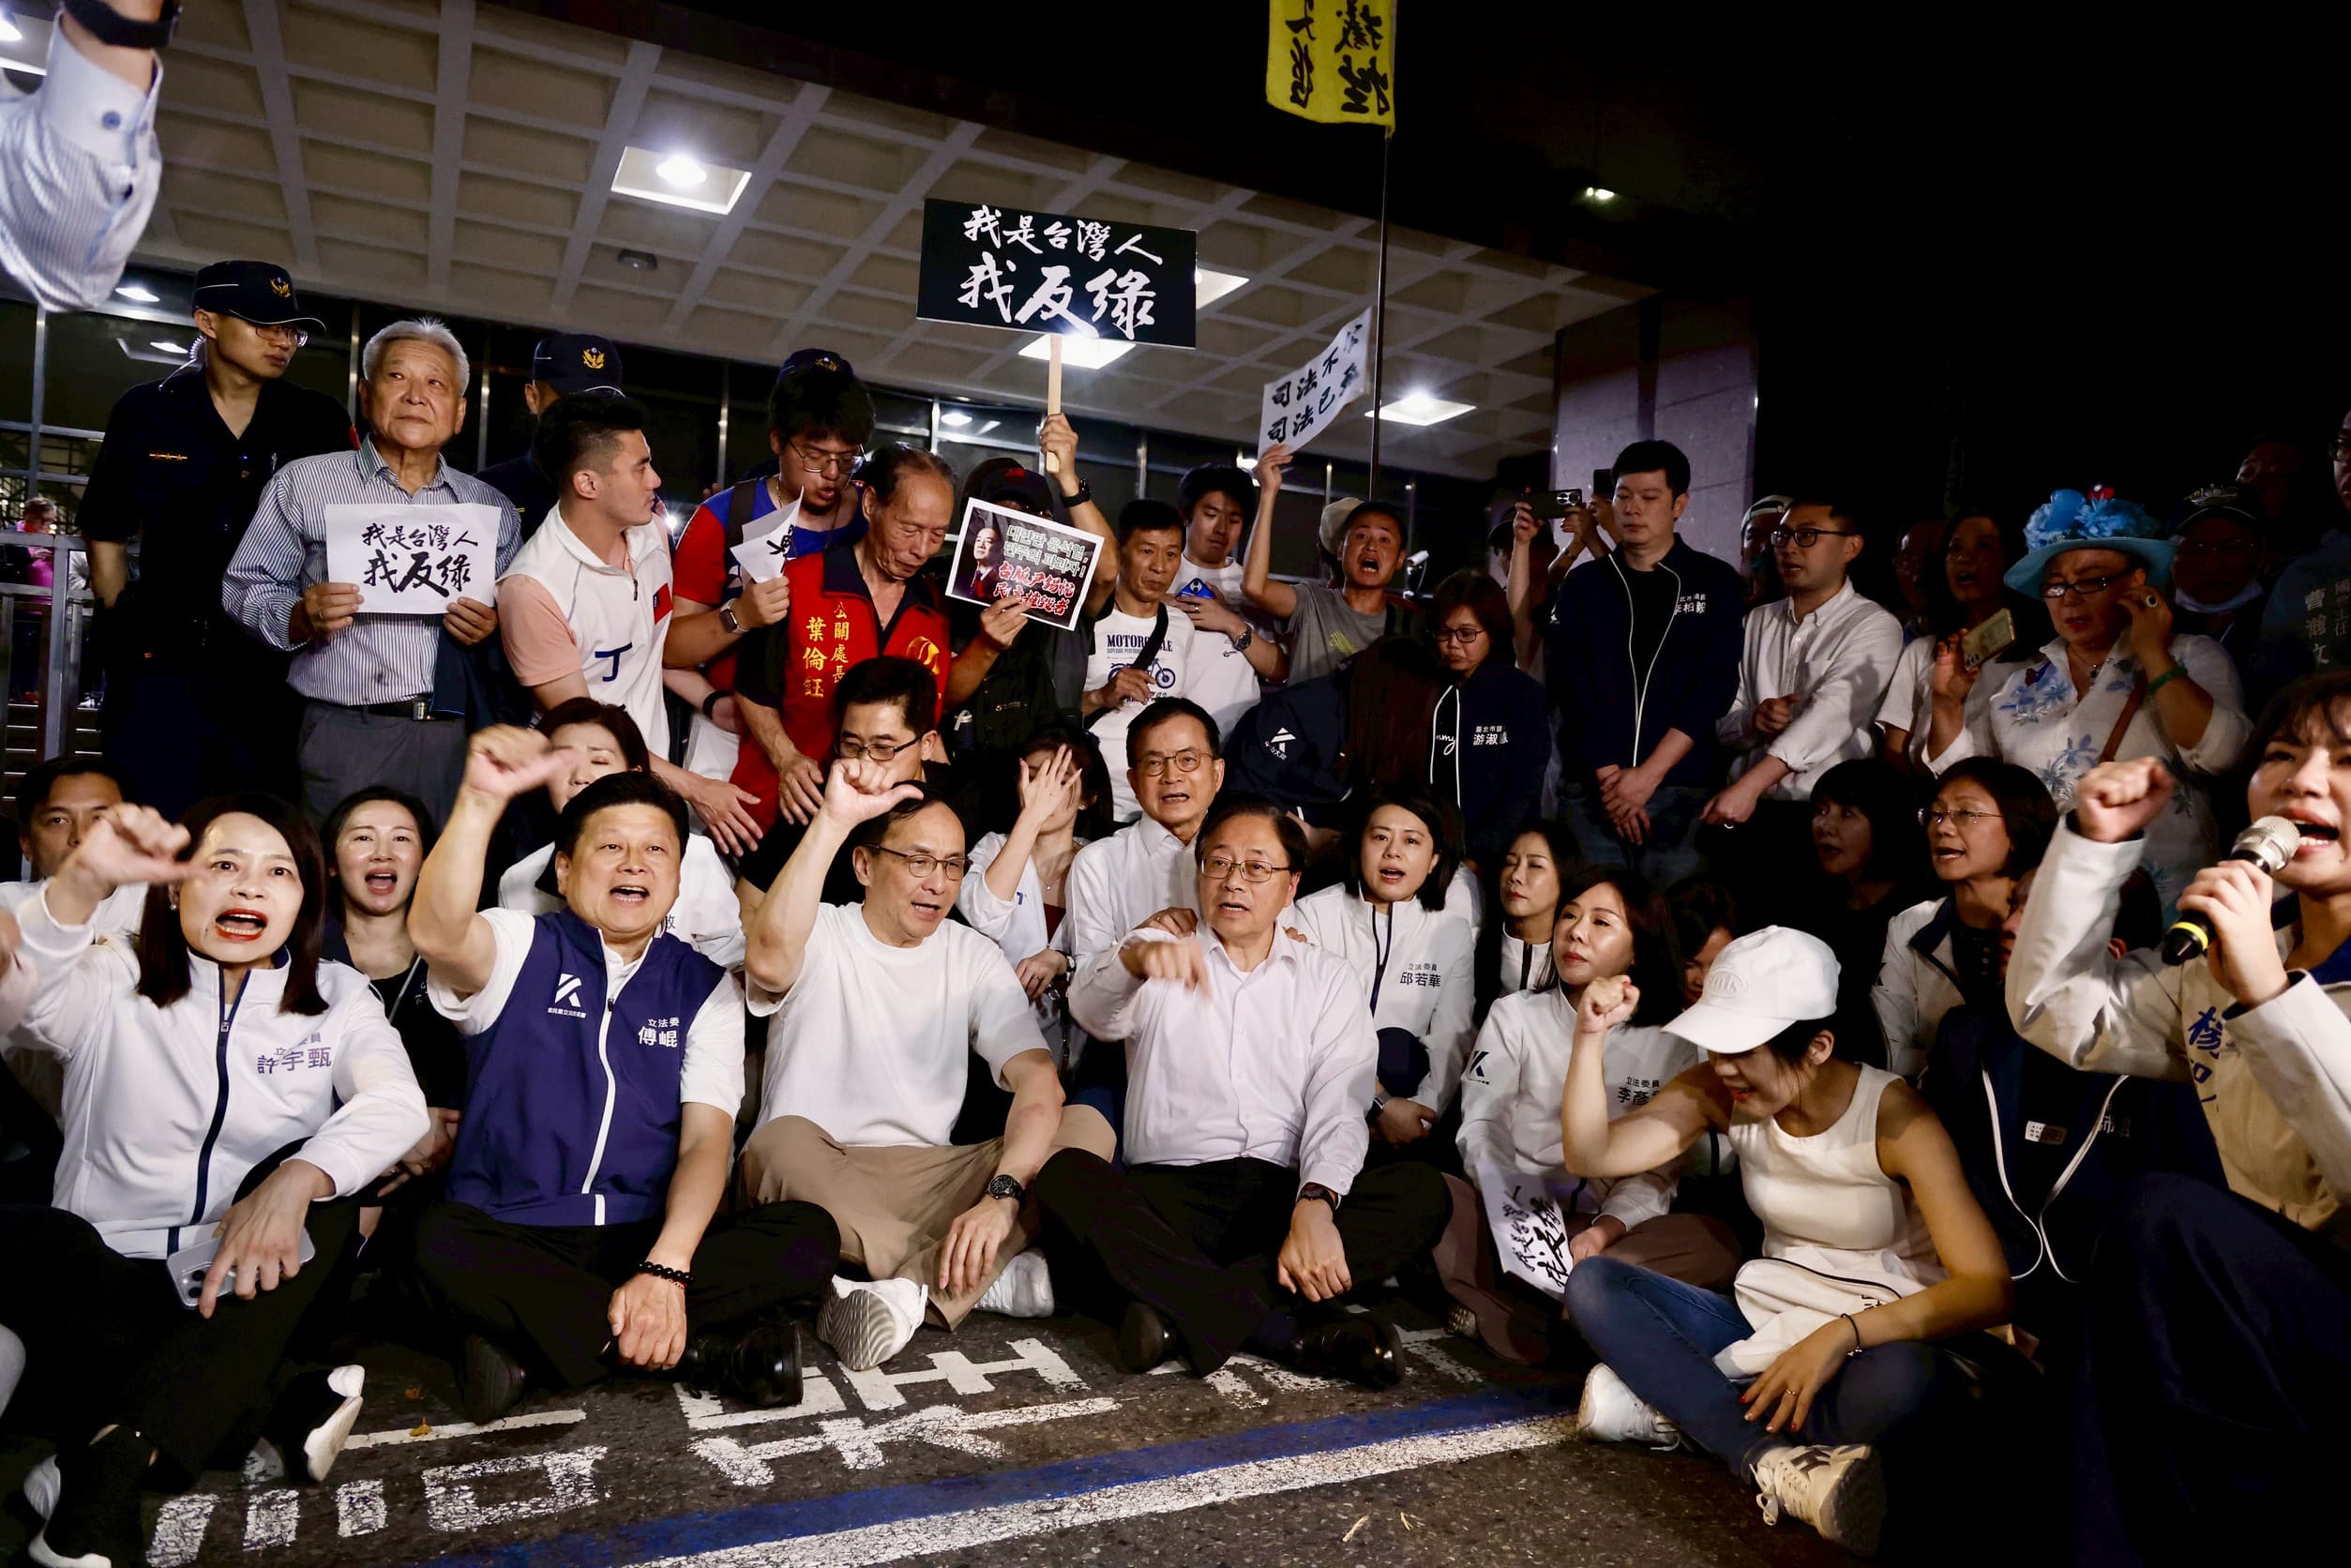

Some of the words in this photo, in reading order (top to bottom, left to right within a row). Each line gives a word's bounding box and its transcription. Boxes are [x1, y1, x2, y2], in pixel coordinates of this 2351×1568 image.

[963, 204, 1163, 265] 我是台灣人
[957, 251, 1157, 340] 我反綠
[362, 522, 478, 551] 我是台灣人
[363, 549, 471, 597] 我反綠
[1618, 1087, 1660, 1106] 李彥
